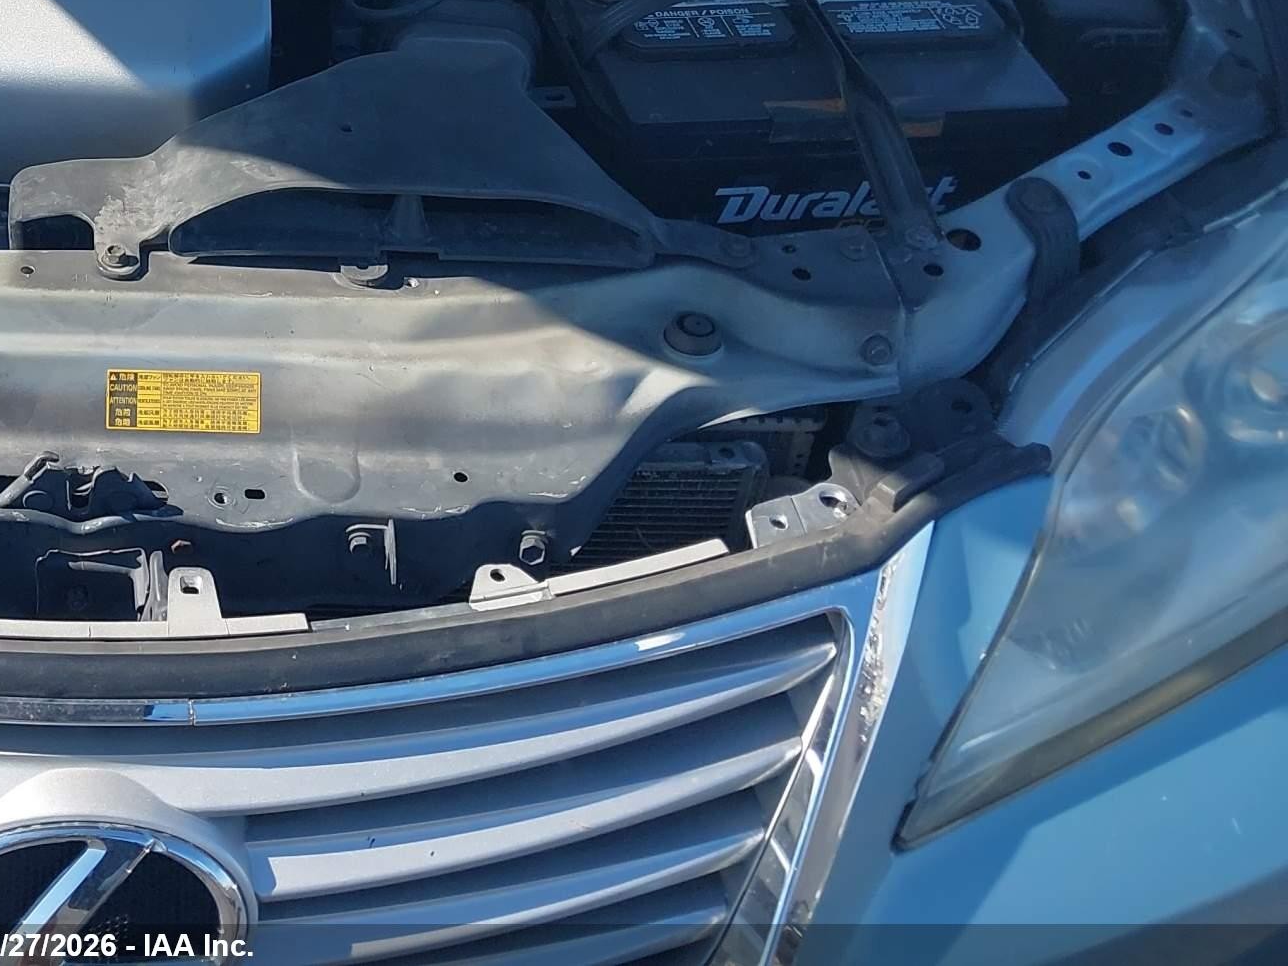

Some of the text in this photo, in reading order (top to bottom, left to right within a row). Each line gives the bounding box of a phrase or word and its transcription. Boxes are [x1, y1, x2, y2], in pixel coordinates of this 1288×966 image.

[654, 9, 699, 18] DANGER
[710, 8, 750, 16] POISON
[715, 176, 956, 224] Duralt
[109, 383, 137, 392] CAUTION
[109, 396, 137, 404] ATTENTION
